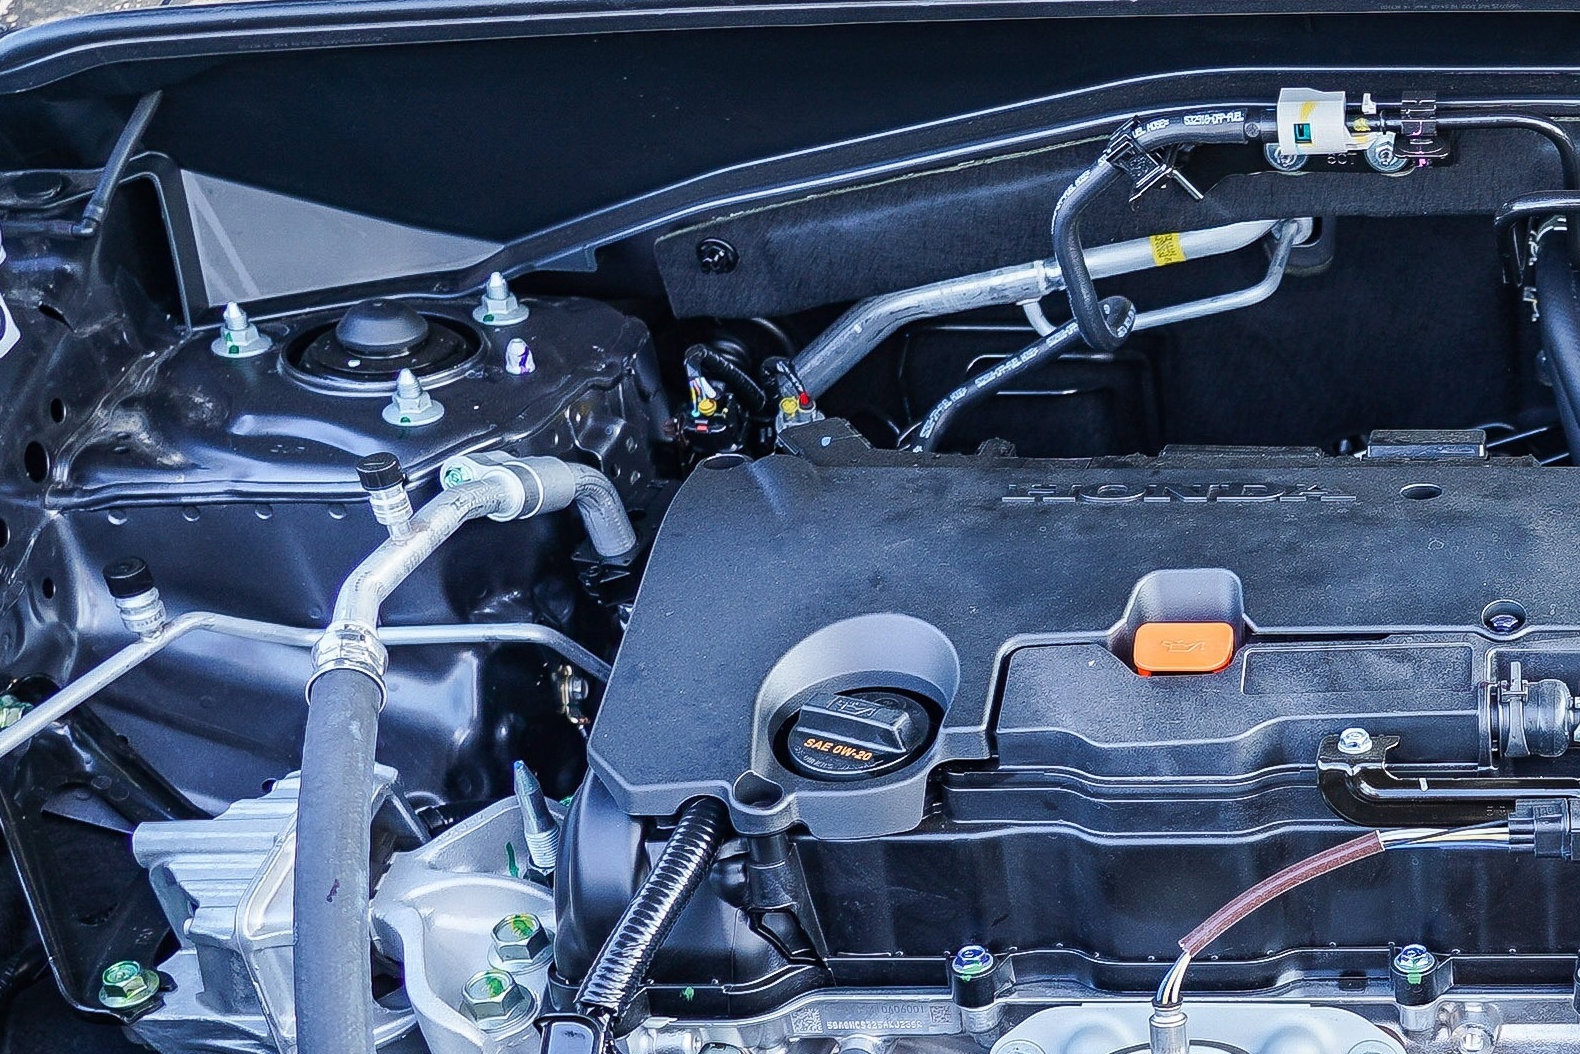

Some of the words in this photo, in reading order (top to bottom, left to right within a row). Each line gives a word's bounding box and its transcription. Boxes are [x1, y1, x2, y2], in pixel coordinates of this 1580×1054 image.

[1002, 484, 1358, 503] HONDA
[803, 738, 834, 752] SAE
[832, 744, 873, 762] 0W-20
